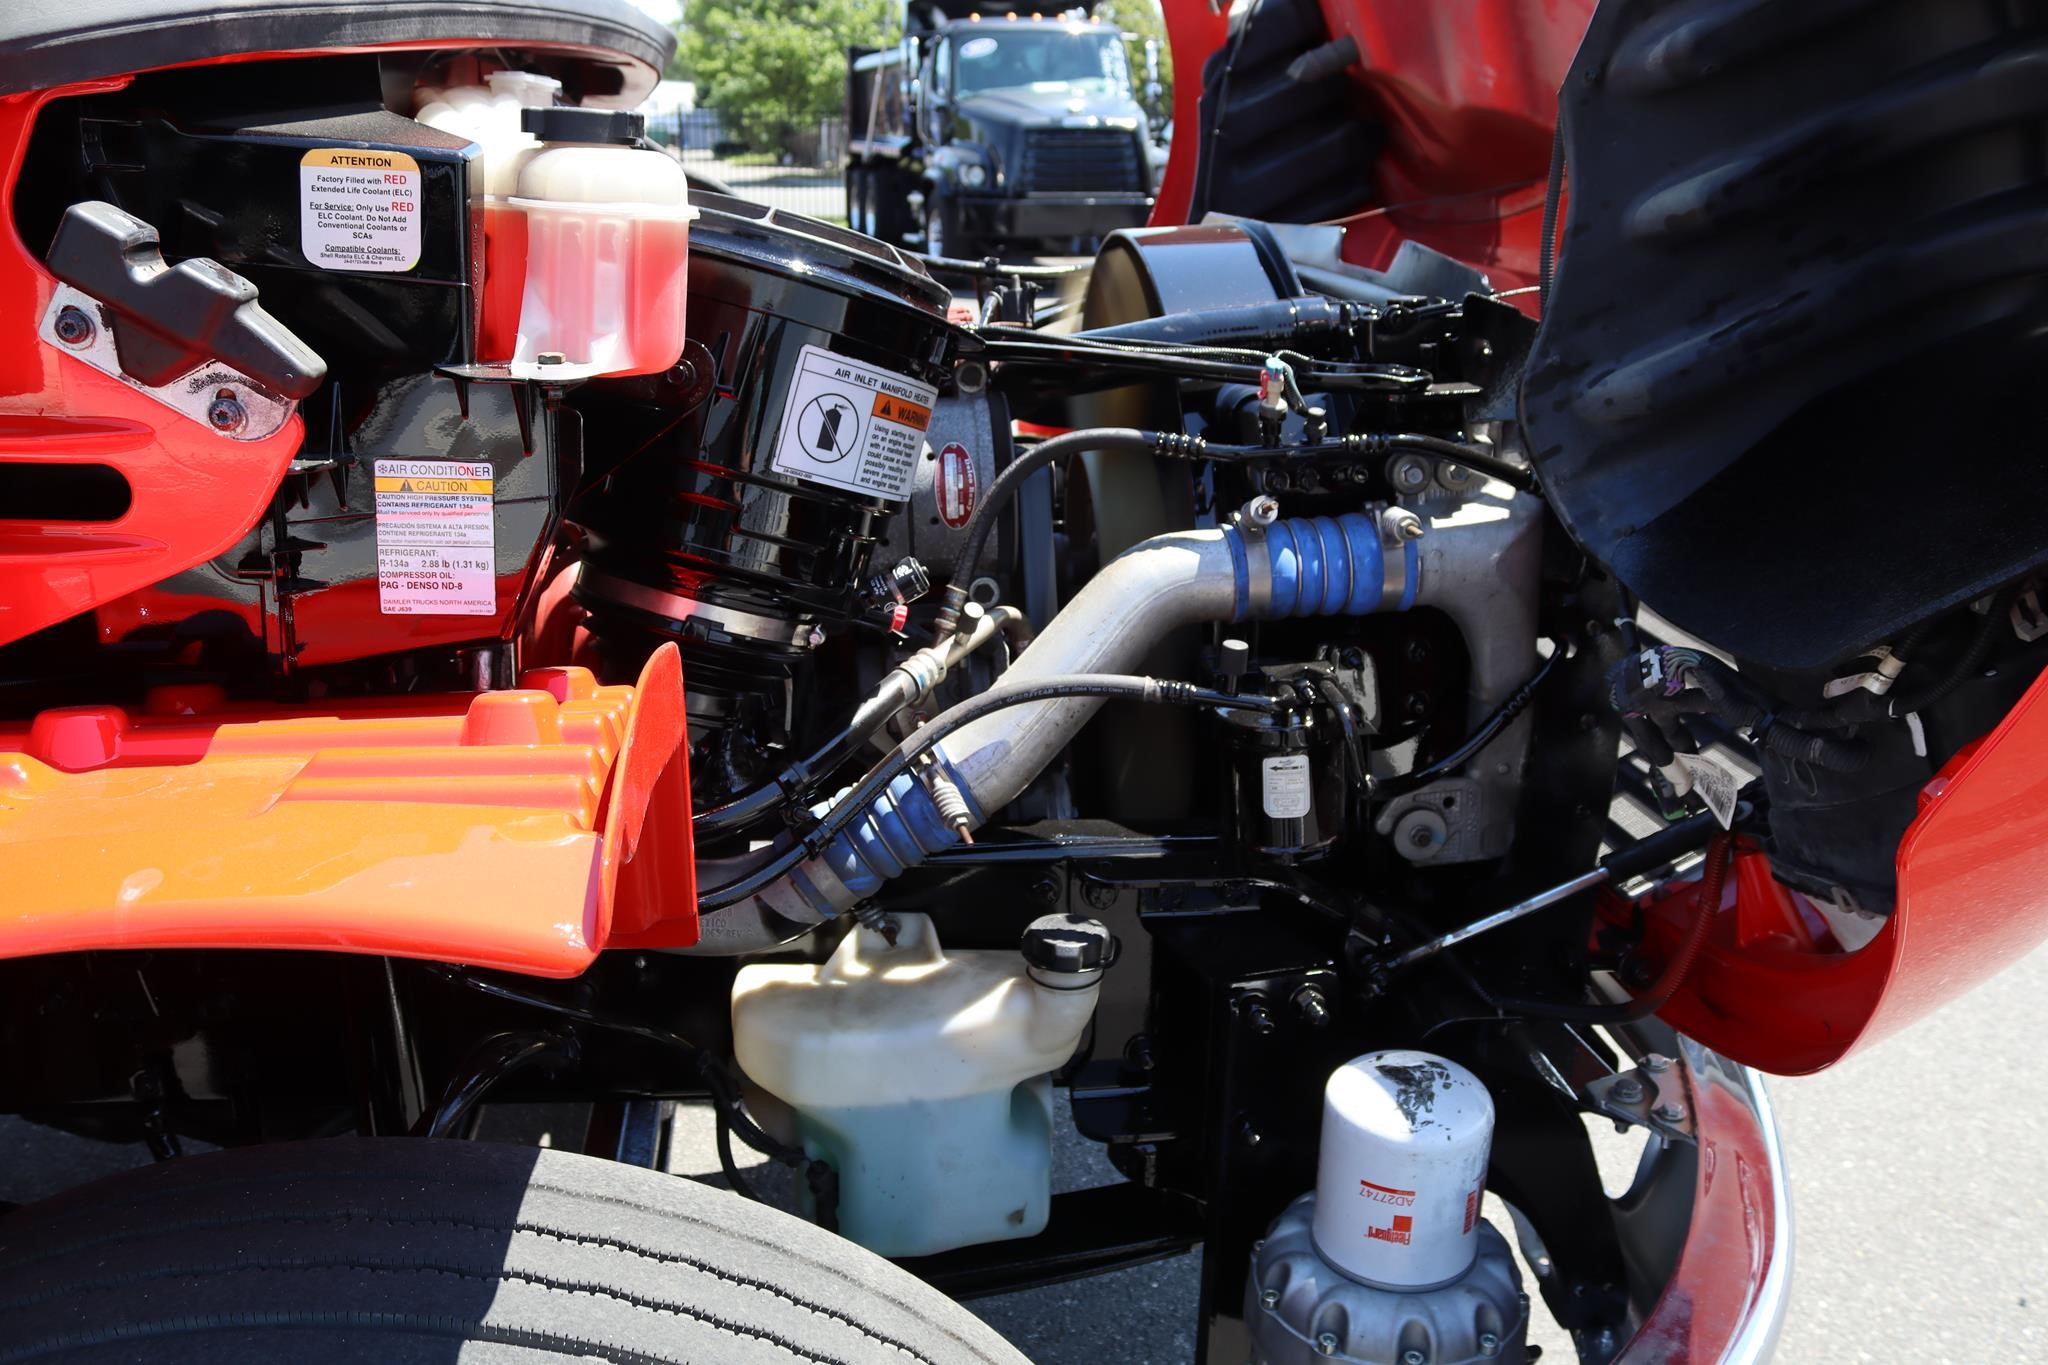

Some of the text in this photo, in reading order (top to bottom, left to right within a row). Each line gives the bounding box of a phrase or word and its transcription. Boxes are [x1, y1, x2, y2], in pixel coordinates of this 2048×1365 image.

[331, 156, 391, 167] ATTENTION
[317, 175, 343, 184] Factory
[346, 176, 364, 184] Filled
[384, 174, 406, 184] RED
[312, 185, 412, 197] Extended Life Coolant (ELC)
[310, 202, 322, 210] For
[325, 203, 354, 212] Service:
[356, 204, 373, 212] Only
[391, 202, 414, 212] RED
[318, 212, 333, 220] ELC
[335, 213, 364, 221] Coolant.
[318, 221, 365, 230] Conventional
[366, 223, 397, 231] Coolants
[325, 244, 400, 255] Compatible Coolants:
[835, 368, 851, 378] AIR
[854, 373, 878, 387] INLET
[880, 381, 913, 398] MANIFOLD
[874, 424, 889, 435] Using
[389, 465, 490, 477] AIR CONDITIONER
[417, 481, 468, 492] CAUTION
[379, 549, 439, 557] REFRIGERANT:
[380, 559, 489, 570] R-134a 2.88 lb (1.31 kg)
[380, 581, 398, 589] PAG
[407, 582, 439, 590] DENSO
[442, 582, 463, 590] ND-8
[1359, 1187, 1414, 1207] AD27747
